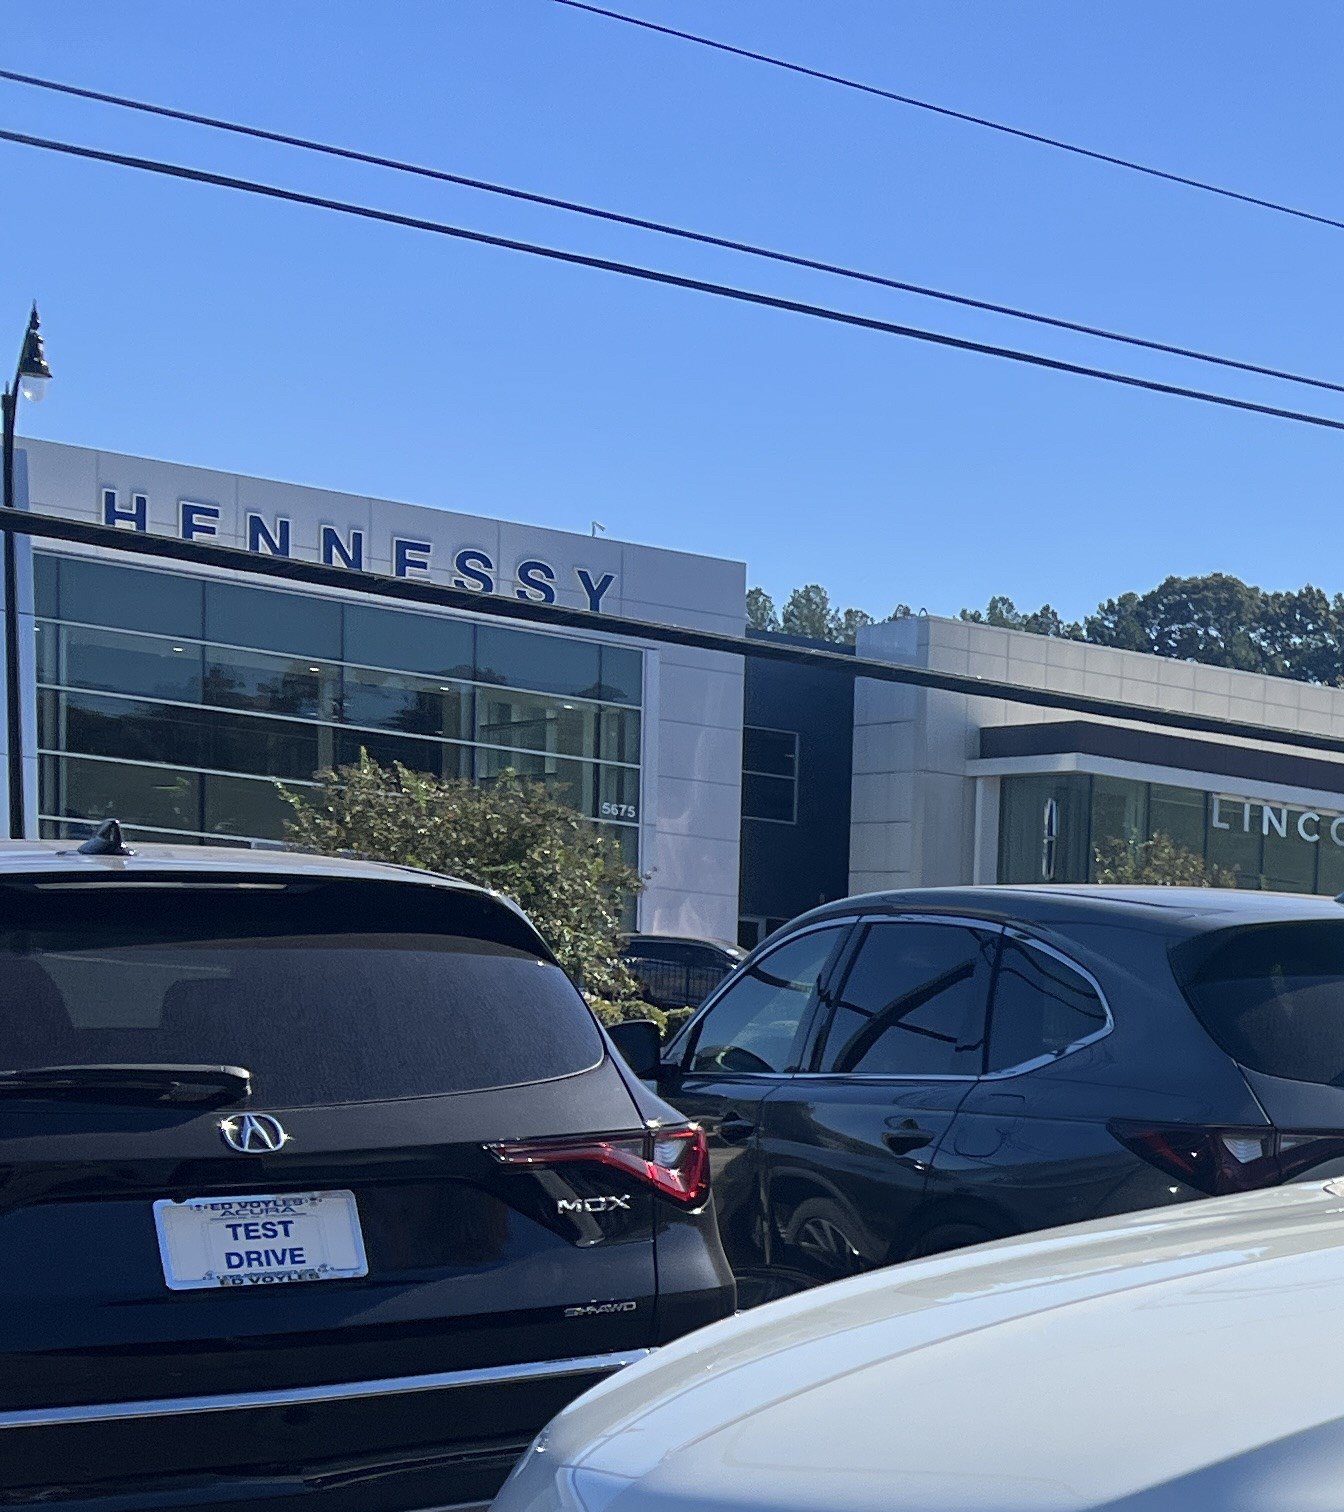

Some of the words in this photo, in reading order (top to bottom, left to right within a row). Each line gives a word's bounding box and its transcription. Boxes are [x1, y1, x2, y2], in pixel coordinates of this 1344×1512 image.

[102, 488, 616, 612] HENNESSY
[601, 802, 636, 818] 5675
[220, 1206, 297, 1217] ACURA
[557, 1194, 631, 1214] MDX
[225, 1220, 294, 1241] TEST
[225, 1247, 306, 1269] DRIVE
